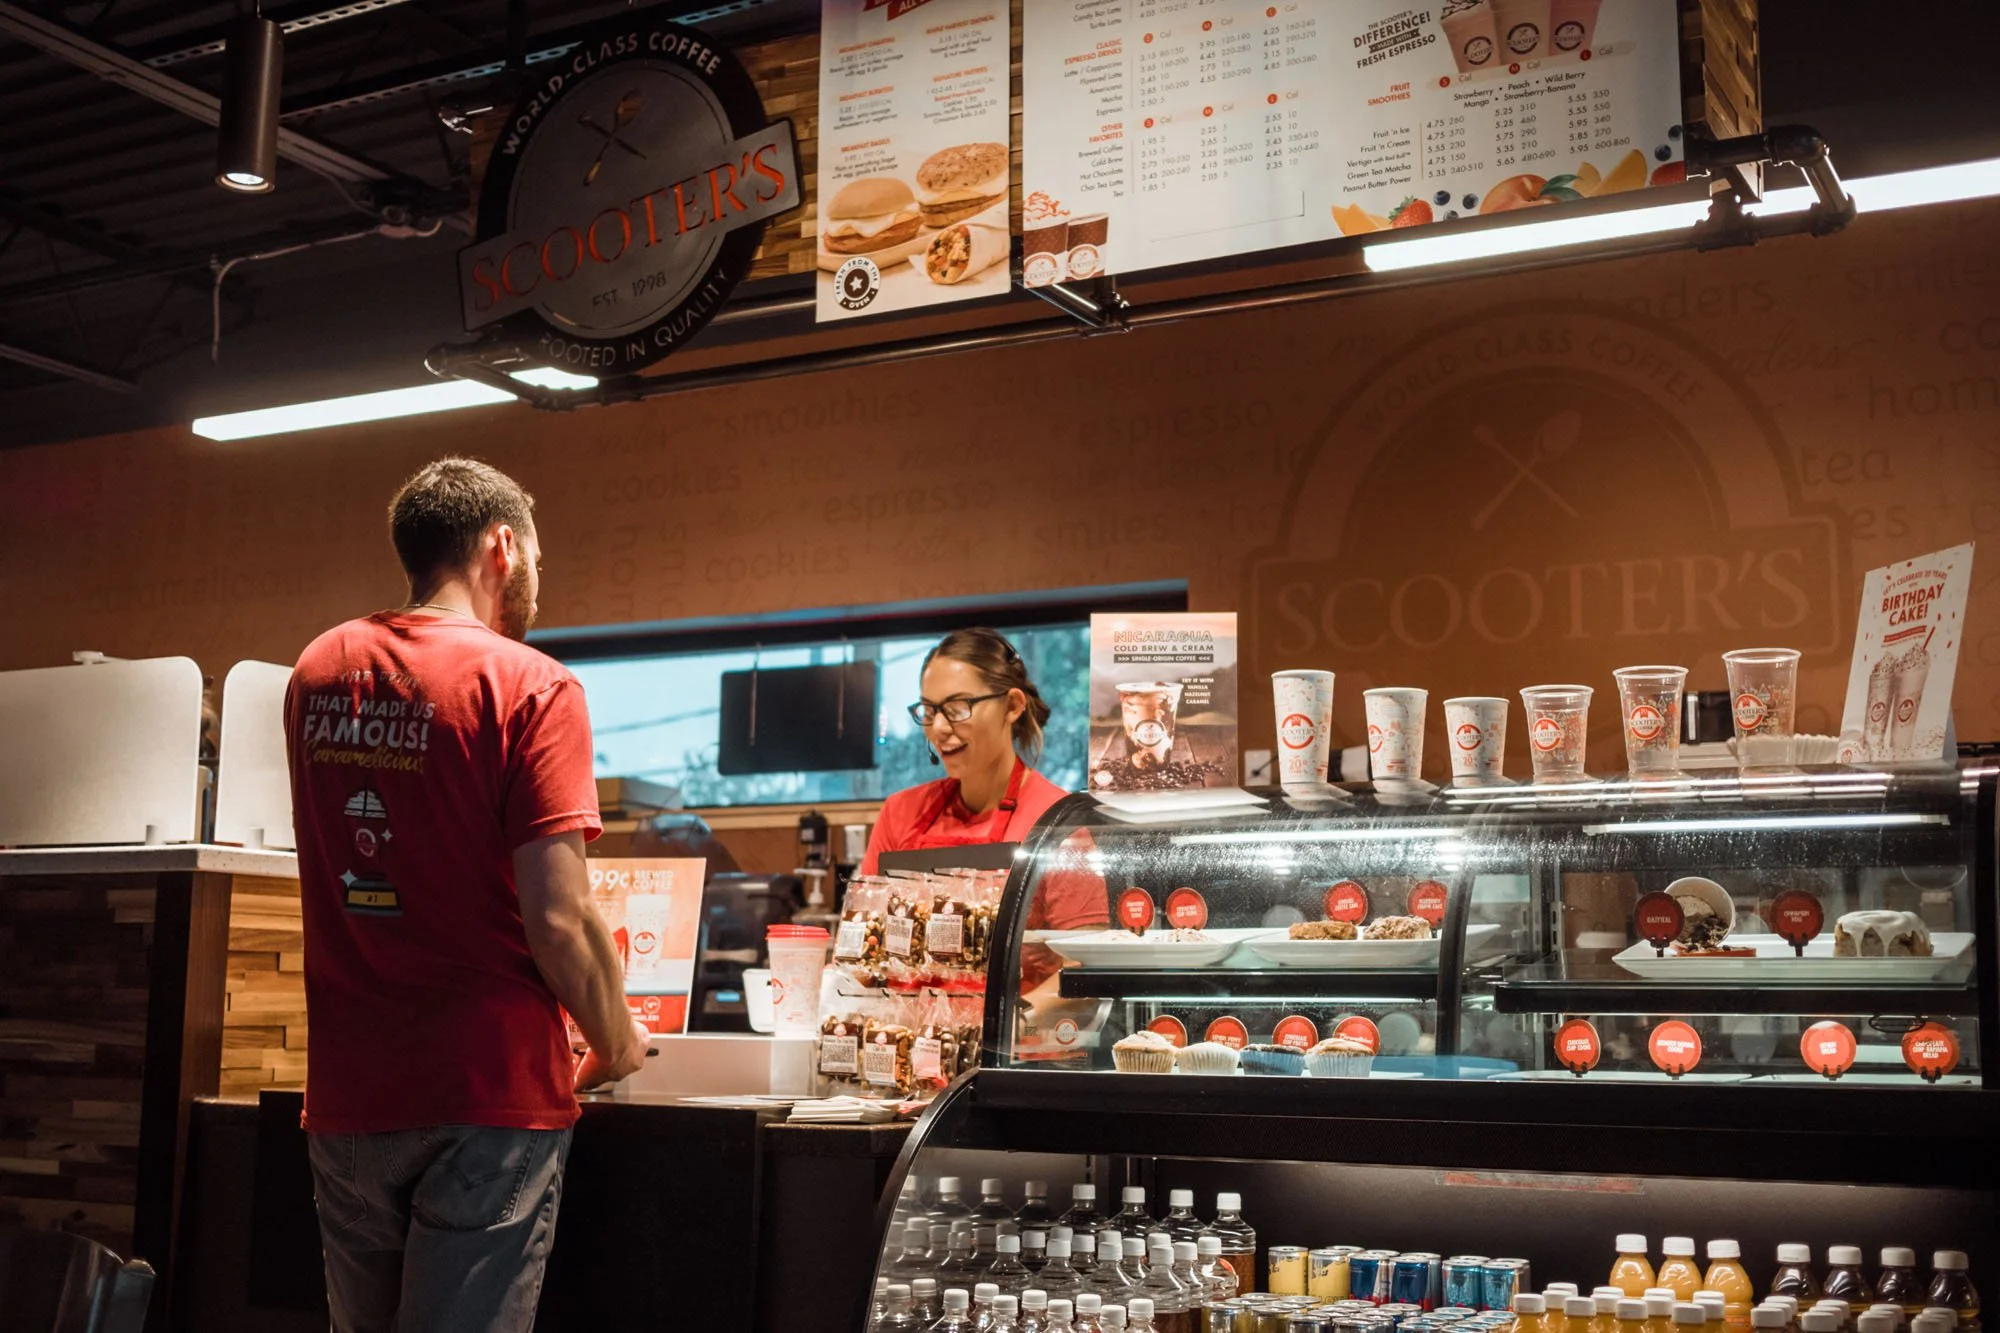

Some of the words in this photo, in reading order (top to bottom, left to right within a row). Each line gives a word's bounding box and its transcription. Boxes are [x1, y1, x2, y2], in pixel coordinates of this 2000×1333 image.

[1380, 10, 1413, 25] SCOOTER'S
[1353, 11, 1431, 48] DIFFERENCE!
[1357, 52, 1386, 68] FRESH
[1389, 34, 1436, 57] ESPRESSO
[503, 33, 640, 155] WORLD-CLASS
[648, 31, 721, 76] COFFEE
[1390, 82, 1410, 92] FRUIT
[1453, 89, 1494, 102] Strawberry
[1508, 81, 1530, 91] Peach
[1544, 73, 1563, 83] Wild
[1565, 72, 1586, 82] Berry
[1463, 99, 1490, 109] Mango
[1504, 83, 1576, 102] Strawberry-Banana
[1368, 92, 1410, 106] SMOOTHIES
[1427, 119, 1445, 129] 4.75
[1373, 131, 1389, 139] Fruit
[1427, 132, 1445, 142] 4.75
[1360, 145, 1376, 153] Fruit
[1387, 140, 1410, 149] Cream
[1347, 158, 1372, 168] Vertigo
[1428, 156, 1446, 165] 4.75
[1347, 169, 1369, 180] Green
[1371, 167, 1382, 175] Tea
[1385, 163, 1411, 173] Matcha
[1343, 182, 1366, 193] Peanut
[1368, 180, 1388, 188] Butter
[1390, 176, 1411, 185] Power
[471, 142, 787, 313] SCOOTER'S
[593, 288, 618, 311] EST
[631, 273, 667, 297] 1998
[537, 335, 617, 367] ROOTED
[626, 338, 646, 363] IN
[654, 268, 731, 346] QUALITY
[1474, 327, 1577, 370] CLASS
[1589, 332, 1707, 406] COFFEE
[1275, 548, 1811, 654] SCOOTER'S
[1882, 582, 1945, 612] BIRTHDAY
[1889, 603, 1928, 626] CAKE!
[1114, 630, 1213, 642] NICARAGUA
[341, 670, 372, 684] THE
[309, 695, 352, 712] THAT
[357, 700, 407, 717] MADE
[413, 702, 435, 719] US
[304, 715, 429, 751] FAMOUS!
[590, 869, 630, 891] 99¢
[635, 870, 674, 879] BREWED
[633, 879, 673, 889] COFFEE
[366, 894, 378, 903] #1
